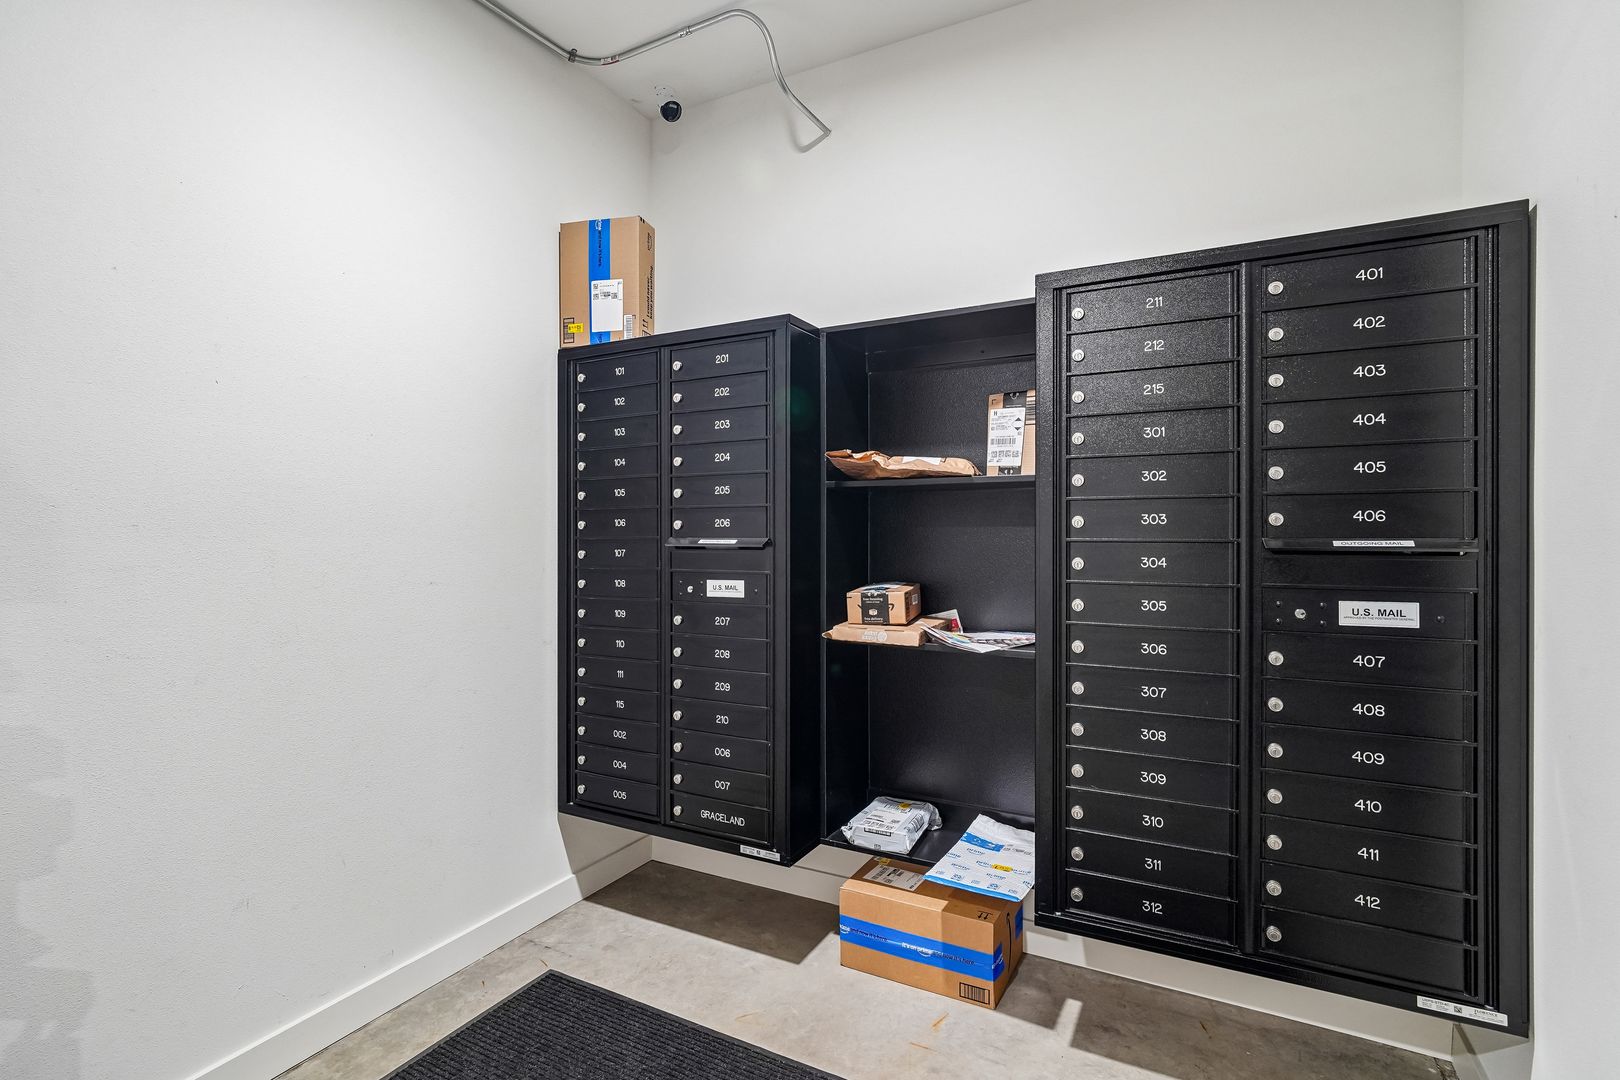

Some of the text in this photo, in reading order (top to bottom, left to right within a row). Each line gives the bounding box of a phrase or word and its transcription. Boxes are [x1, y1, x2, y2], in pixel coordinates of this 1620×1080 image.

[1355, 266, 1383, 281] 401
[1146, 296, 1163, 308] 211
[1352, 315, 1386, 330] 402
[1144, 339, 1165, 352] 212
[715, 353, 729, 364] 201
[614, 366, 625, 376] 101
[1352, 363, 1387, 378] 403
[714, 386, 731, 397] 202
[1143, 383, 1165, 395] 215
[614, 396, 626, 406] 102
[714, 419, 731, 430] 203
[1352, 412, 1387, 426] 404
[614, 427, 626, 437] 103
[1143, 426, 1166, 438] 301
[613, 457, 626, 467] 104
[714, 452, 731, 463] 204
[1353, 460, 1387, 474] 405
[1141, 470, 1167, 482] 302
[614, 488, 626, 498] 105
[714, 485, 731, 495] 205
[1140, 513, 1168, 525] 303
[1352, 509, 1386, 522] 406
[614, 518, 626, 527] 106
[714, 518, 731, 528] 206
[614, 548, 626, 558] 107
[1140, 556, 1168, 569] 304
[614, 579, 626, 588] 108
[1140, 599, 1167, 612] 305
[614, 609, 626, 618] 109
[1352, 608, 1407, 618] U.S. MAIL
[714, 616, 731, 626] 207
[615, 639, 626, 649] 110
[1140, 642, 1168, 656] 306
[714, 649, 731, 659] 208
[1352, 654, 1386, 668] 407
[616, 669, 624, 679] 111
[714, 681, 731, 692] 209
[1140, 685, 1167, 699] 307
[615, 700, 625, 709] 115
[1352, 703, 1386, 717] 408
[715, 714, 729, 725] 210
[613, 729, 627, 740] 002
[1140, 728, 1167, 742] 308
[714, 747, 731, 758] 006
[1351, 750, 1385, 765] 409
[612, 759, 627, 770] 004
[1140, 771, 1167, 785] 309
[714, 779, 731, 791] 007
[612, 789, 627, 800] 005
[1354, 799, 1382, 813] 410
[700, 809, 746, 827] GRACELAND
[1142, 814, 1164, 829] 310
[1357, 847, 1379, 862] 411
[1144, 857, 1162, 871] 311
[1142, 900, 1163, 915] 312
[1354, 894, 1381, 910] 412
